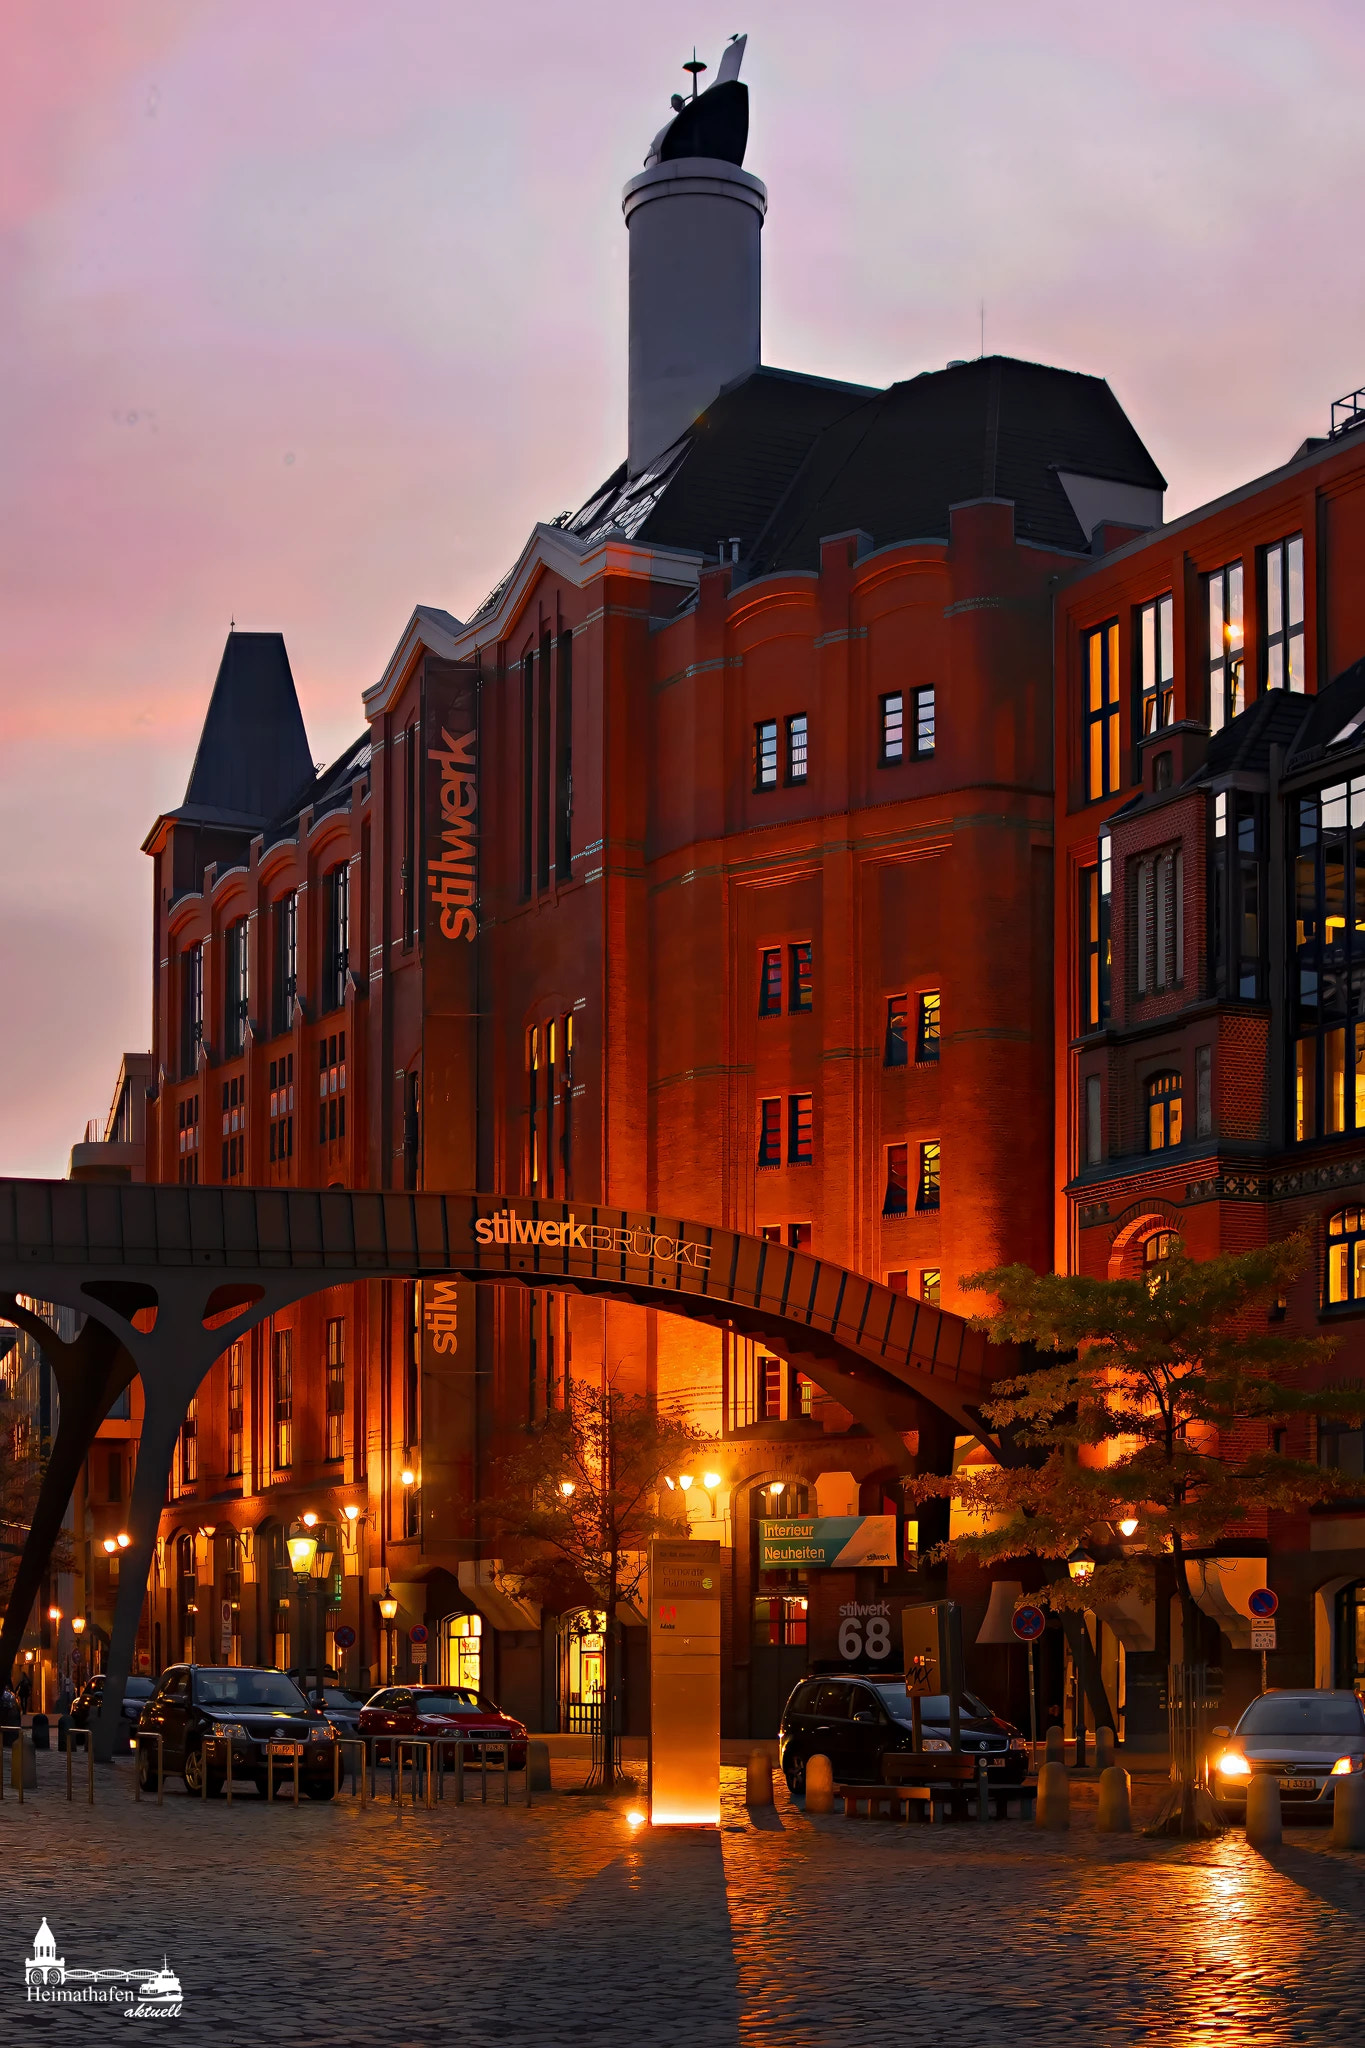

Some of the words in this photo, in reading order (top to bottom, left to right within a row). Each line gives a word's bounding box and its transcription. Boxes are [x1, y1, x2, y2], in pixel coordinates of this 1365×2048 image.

[426, 726, 478, 943] stilwerk
[763, 1522, 815, 1537] Interieur
[764, 1545, 826, 1560] Neuheiten
[865, 1552, 891, 1561] stilwerk
[662, 1566, 705, 1579] Corporate
[838, 1600, 892, 1617] stilwerk
[838, 1616, 892, 1660] 68
